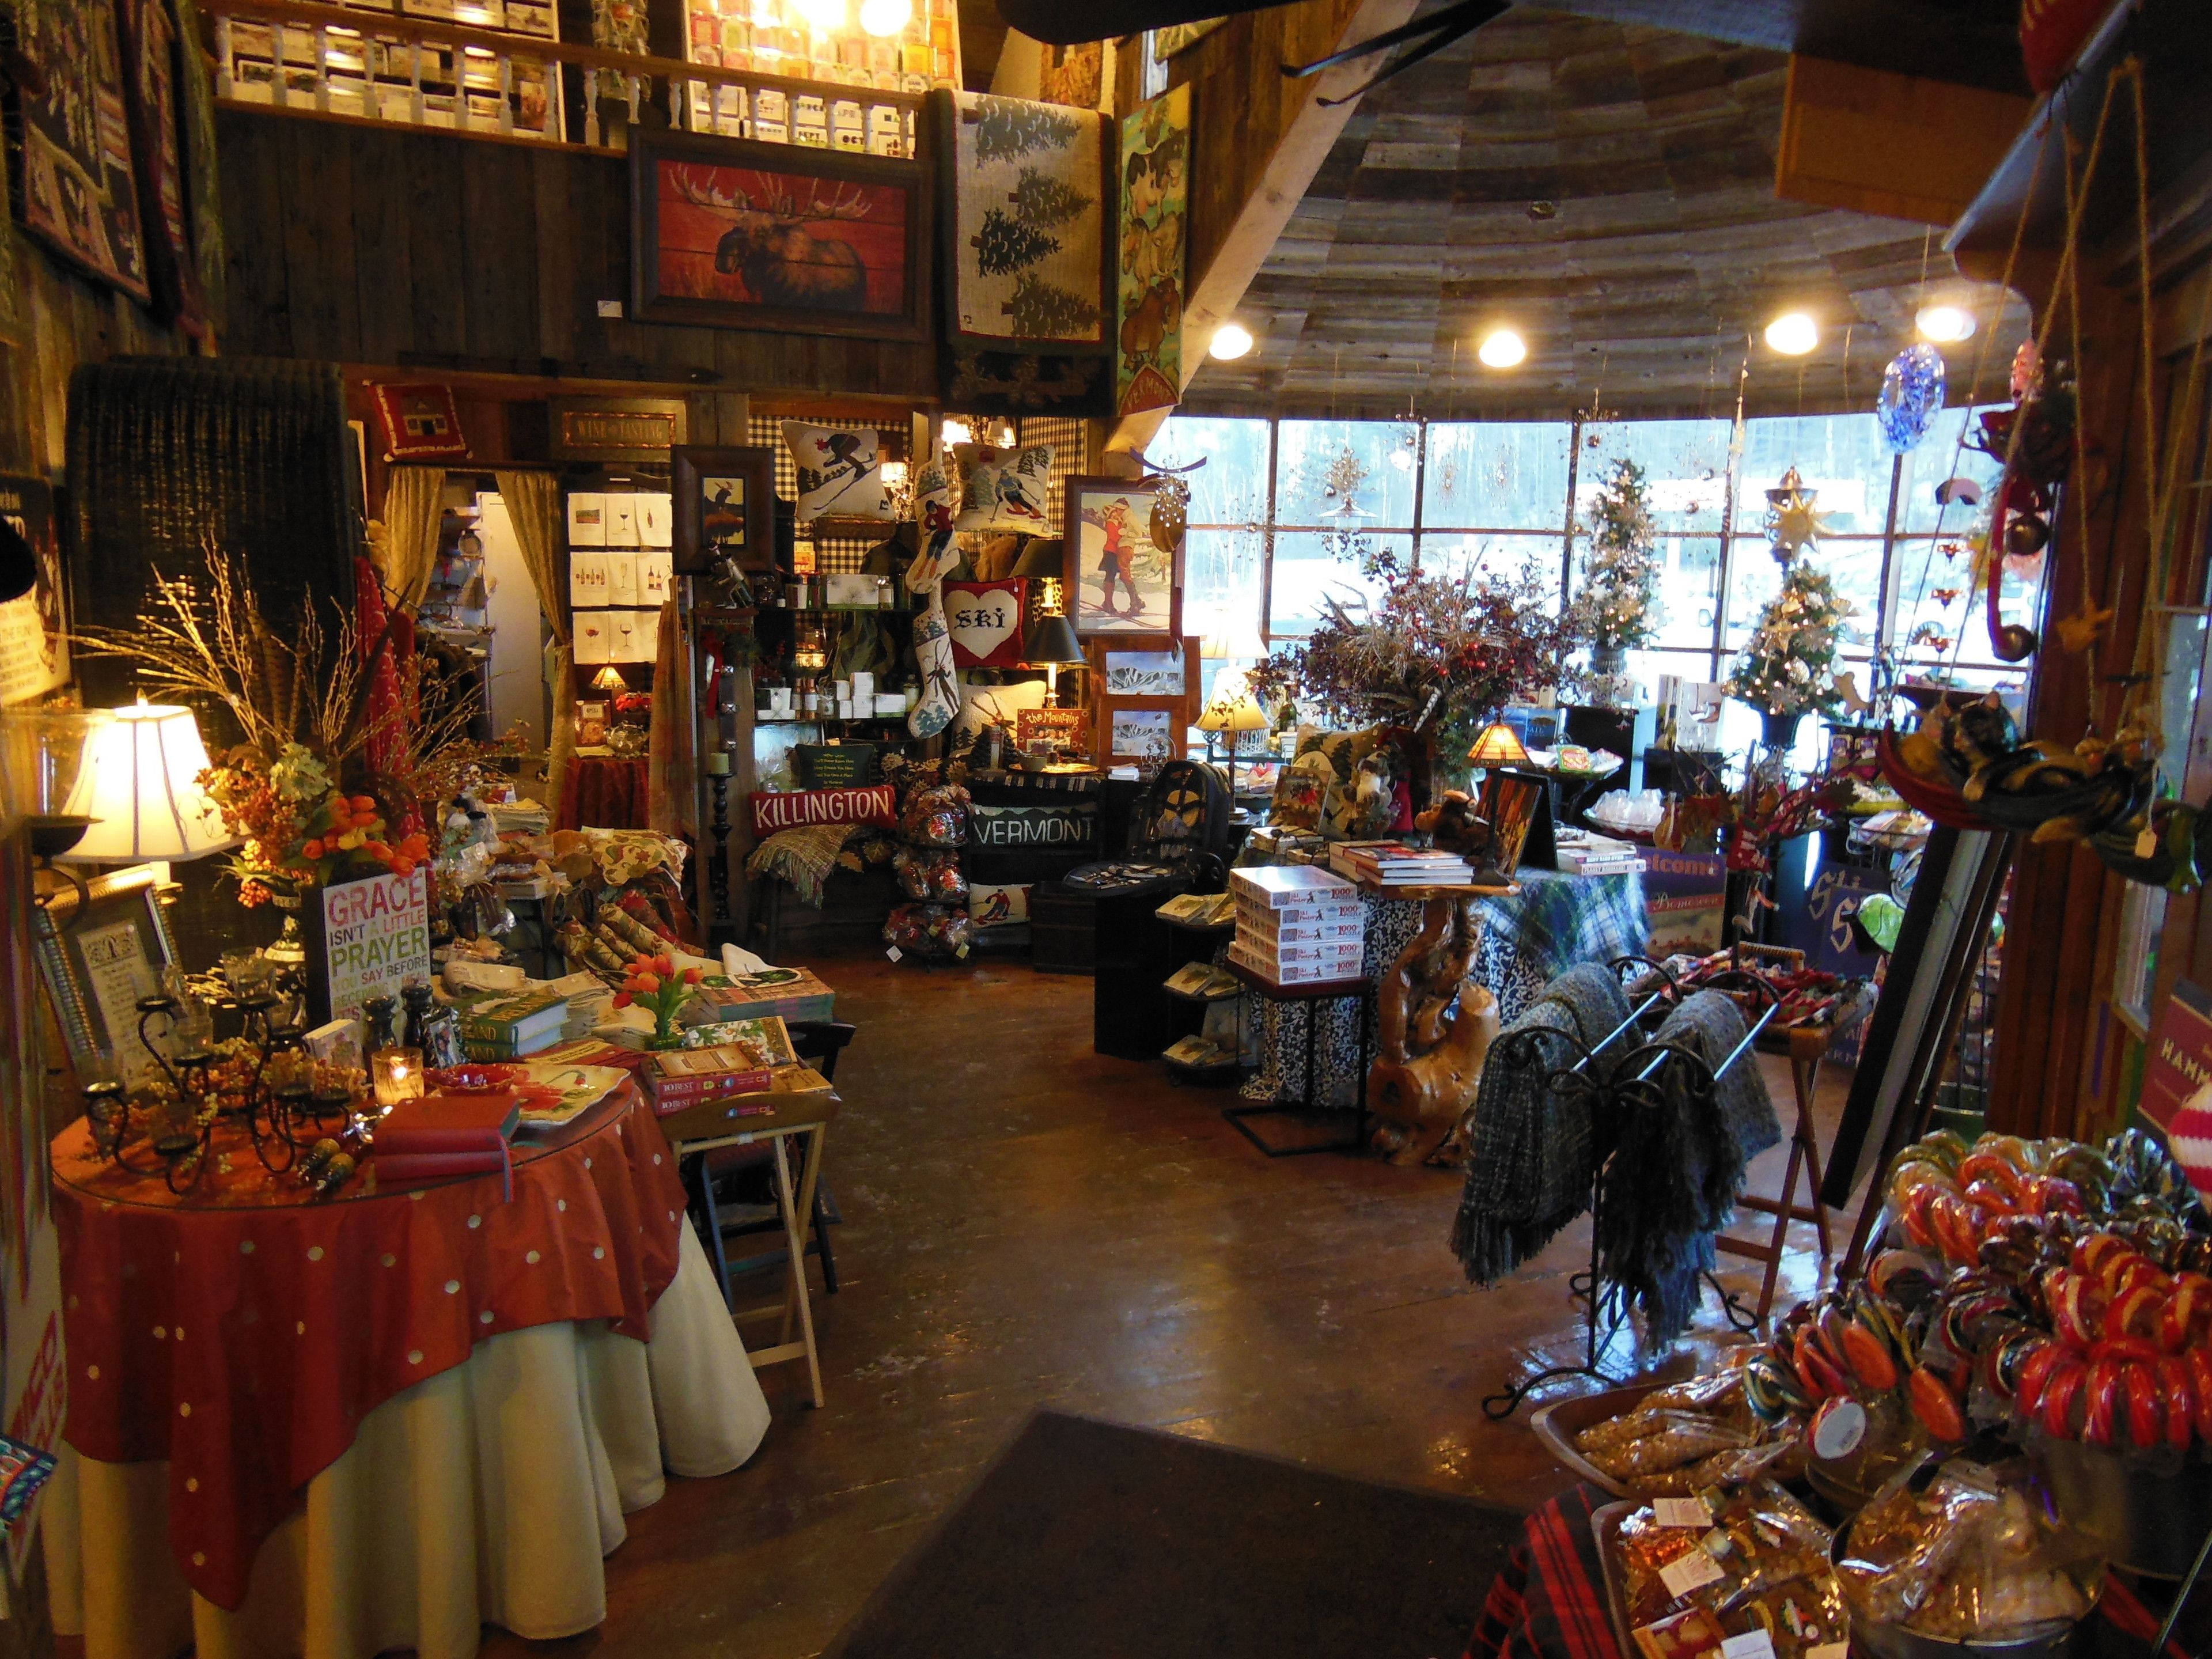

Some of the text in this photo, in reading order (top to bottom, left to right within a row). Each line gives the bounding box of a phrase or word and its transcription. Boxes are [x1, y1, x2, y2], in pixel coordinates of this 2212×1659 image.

[1026, 711, 1079, 725] the Mountains
[755, 790, 889, 828] KILLINGTON
[973, 816, 1094, 844] VERMONT
[1646, 853, 1719, 877] elcome
[329, 872, 425, 927] GRACE
[1331, 888, 1351, 899] 1000
[1339, 905, 1358, 916] 1000
[329, 923, 365, 946] ISN'T
[383, 908, 425, 933] LITTLE
[1337, 924, 1357, 935] 1000
[330, 926, 427, 978] PRAYER
[1337, 944, 1357, 955] 1000
[361, 967, 383, 985] SAY
[387, 955, 428, 978] BEFORE
[1336, 961, 1355, 973] 1000
